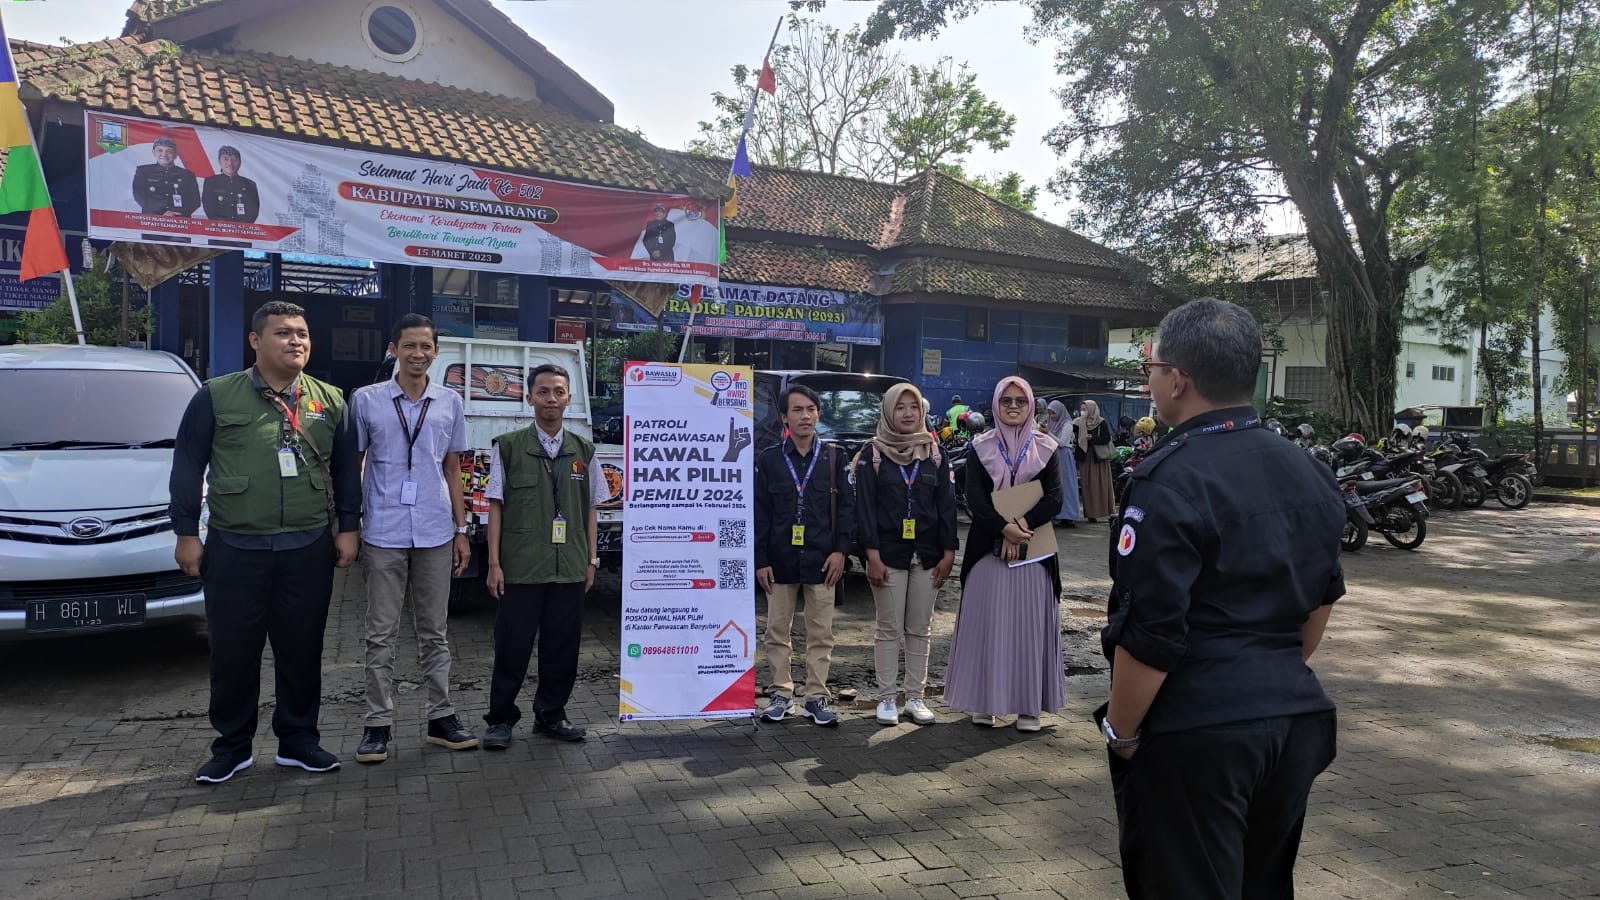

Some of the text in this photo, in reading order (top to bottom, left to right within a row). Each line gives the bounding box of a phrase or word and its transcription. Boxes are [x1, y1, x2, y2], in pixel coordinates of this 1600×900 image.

[358, 160, 417, 182] Selamat
[422, 168, 456, 187] Hari
[456, 173, 491, 193] Jadi
[519, 183, 544, 200] 502
[351, 185, 548, 220] KABUPATEN SEMARANG
[380, 209, 425, 224] Ekonomi
[387, 225, 440, 241] Berdikari
[485, 236, 518, 249] Nyata
[416, 248, 493, 262] 15 MARET 2023
[678, 284, 831, 307] SLAMAT DATANG
[664, 299, 845, 324] RADISI PADUSAN (2023)
[645, 370, 677, 378] BAWASLU
[735, 381, 747, 390] AYO
[726, 390, 747, 398] AWASI
[633, 419, 688, 429] PATROLI
[633, 433, 726, 443] PENGAWASAN
[633, 447, 715, 462] KAWAL
[633, 467, 742, 483] HAK PILIH
[632, 488, 743, 501] PEMILU 2024
[35, 598, 138, 620] H 8611 WL
[640, 607, 661, 615] datang
[661, 607, 690, 615] langsung
[642, 645, 699, 655] 089648611010
